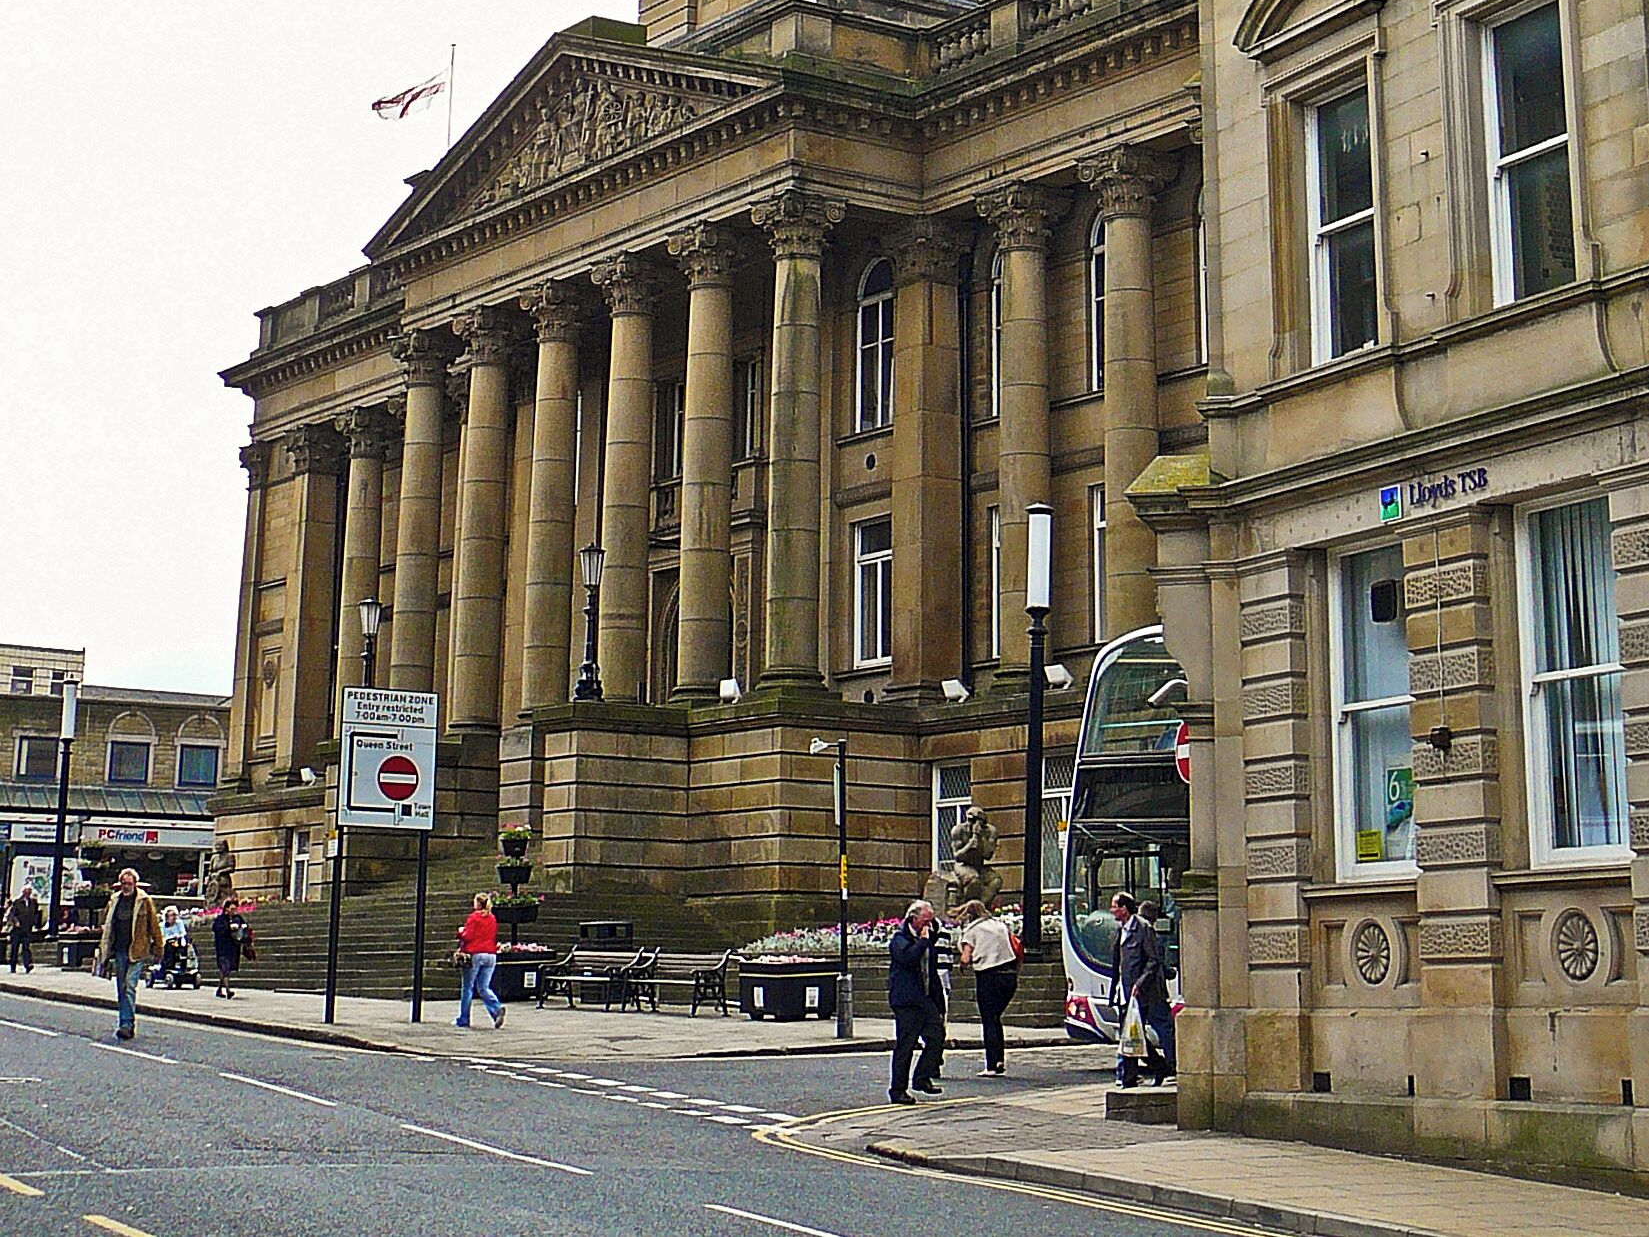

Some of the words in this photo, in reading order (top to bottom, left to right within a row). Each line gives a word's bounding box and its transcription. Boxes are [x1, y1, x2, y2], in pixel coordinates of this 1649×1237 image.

[1408, 475, 1457, 509] Lloyds
[1457, 467, 1488, 493] TSB
[347, 691, 406, 703] PEDESTRIAN
[408, 695, 434, 705] ZONE
[357, 701, 380, 712] Entry
[382, 704, 424, 714] restricted
[356, 739, 384, 749] Queen
[386, 741, 413, 751] Street
